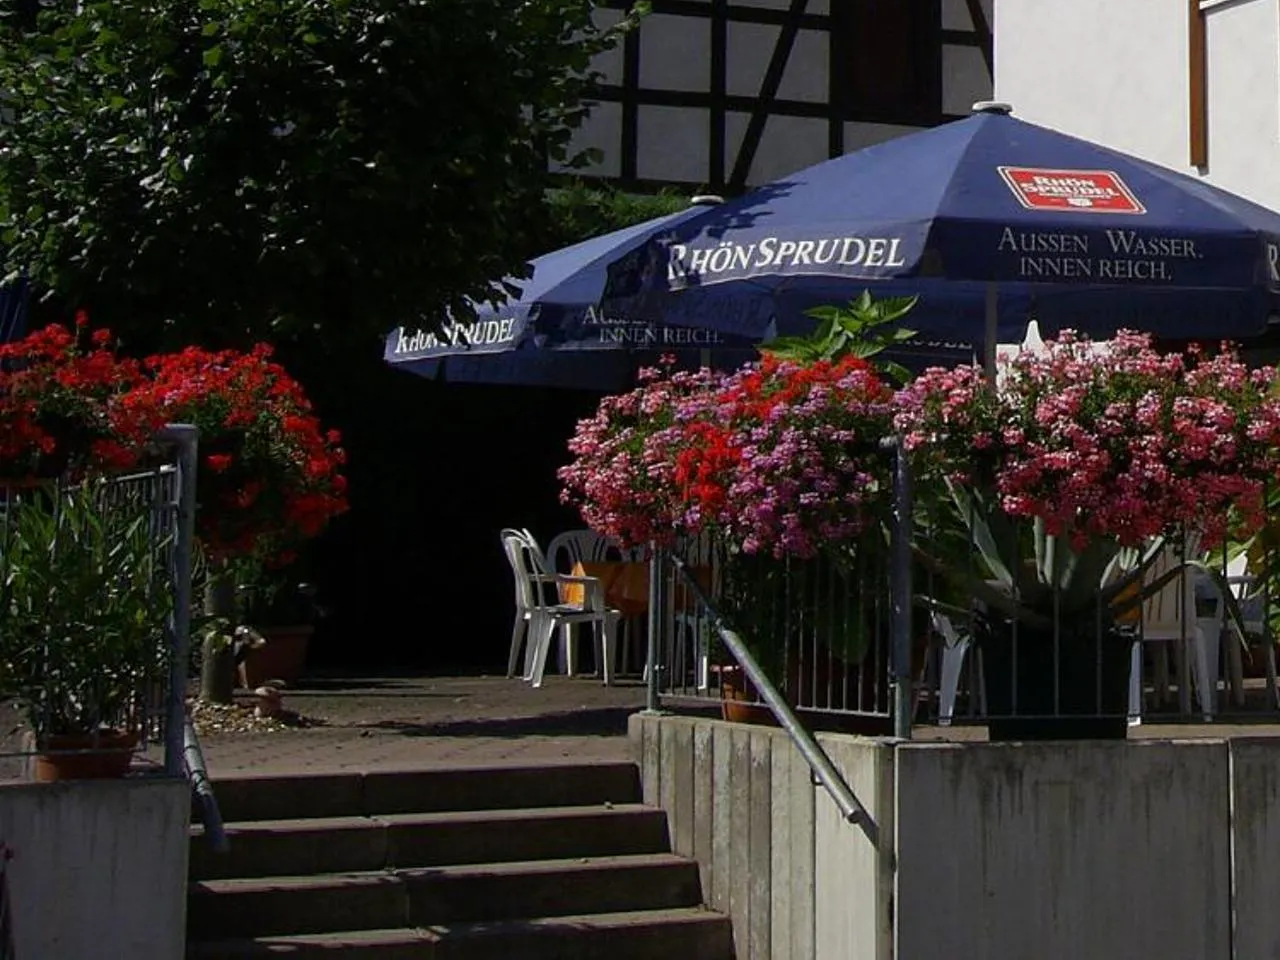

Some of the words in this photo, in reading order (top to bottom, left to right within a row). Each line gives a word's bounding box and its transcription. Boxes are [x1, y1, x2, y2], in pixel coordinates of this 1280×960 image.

[997, 226, 1089, 254] AUSSEN
[1105, 229, 1205, 259] WASSER.
[1020, 256, 1092, 277] INNEN
[1099, 259, 1173, 281] REICH.
[600, 326, 658, 344] INNEN
